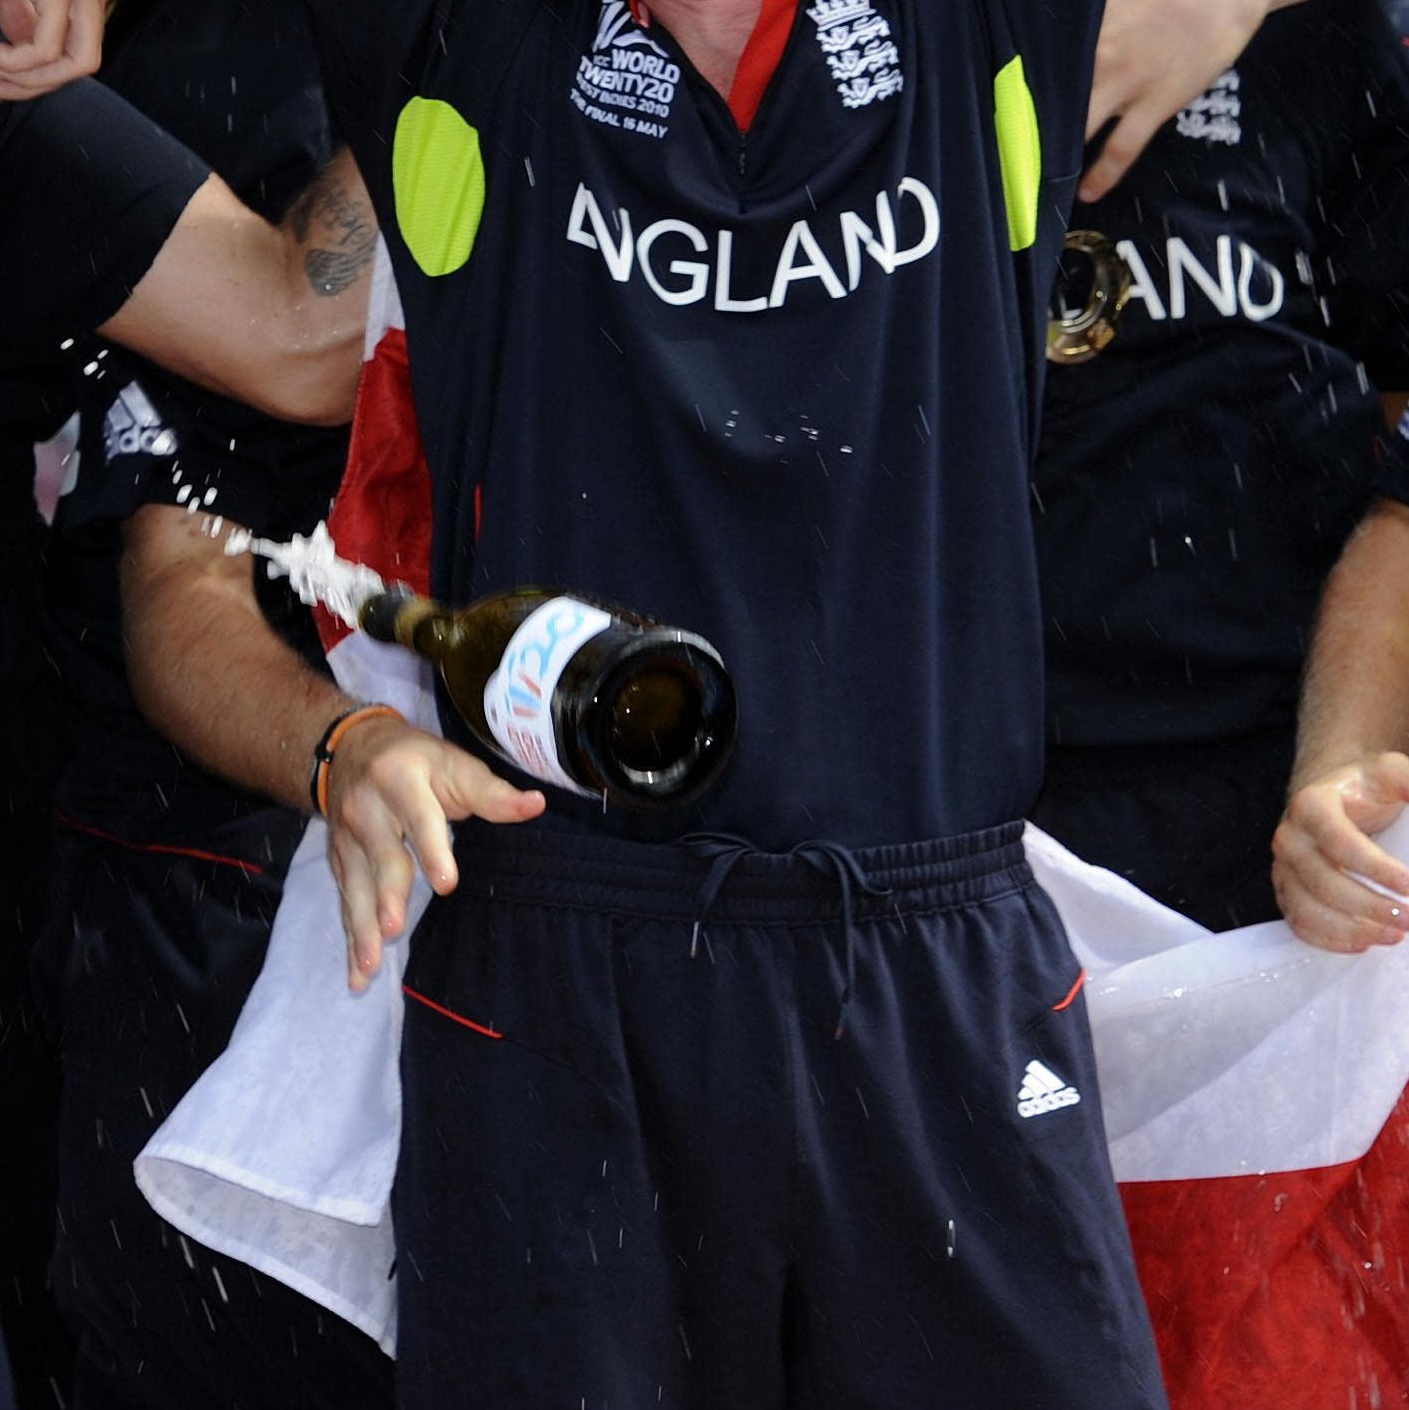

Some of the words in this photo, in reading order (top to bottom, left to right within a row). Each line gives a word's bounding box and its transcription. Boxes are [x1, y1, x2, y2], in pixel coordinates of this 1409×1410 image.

[579, 54, 675, 104] TWENTY20
[611, 47, 682, 84] WORLD
[583, 104, 622, 128] FINAL
[635, 119, 670, 140] MAY
[636, 97, 671, 119] 2010
[1016, 1086, 1082, 1119] adidas
